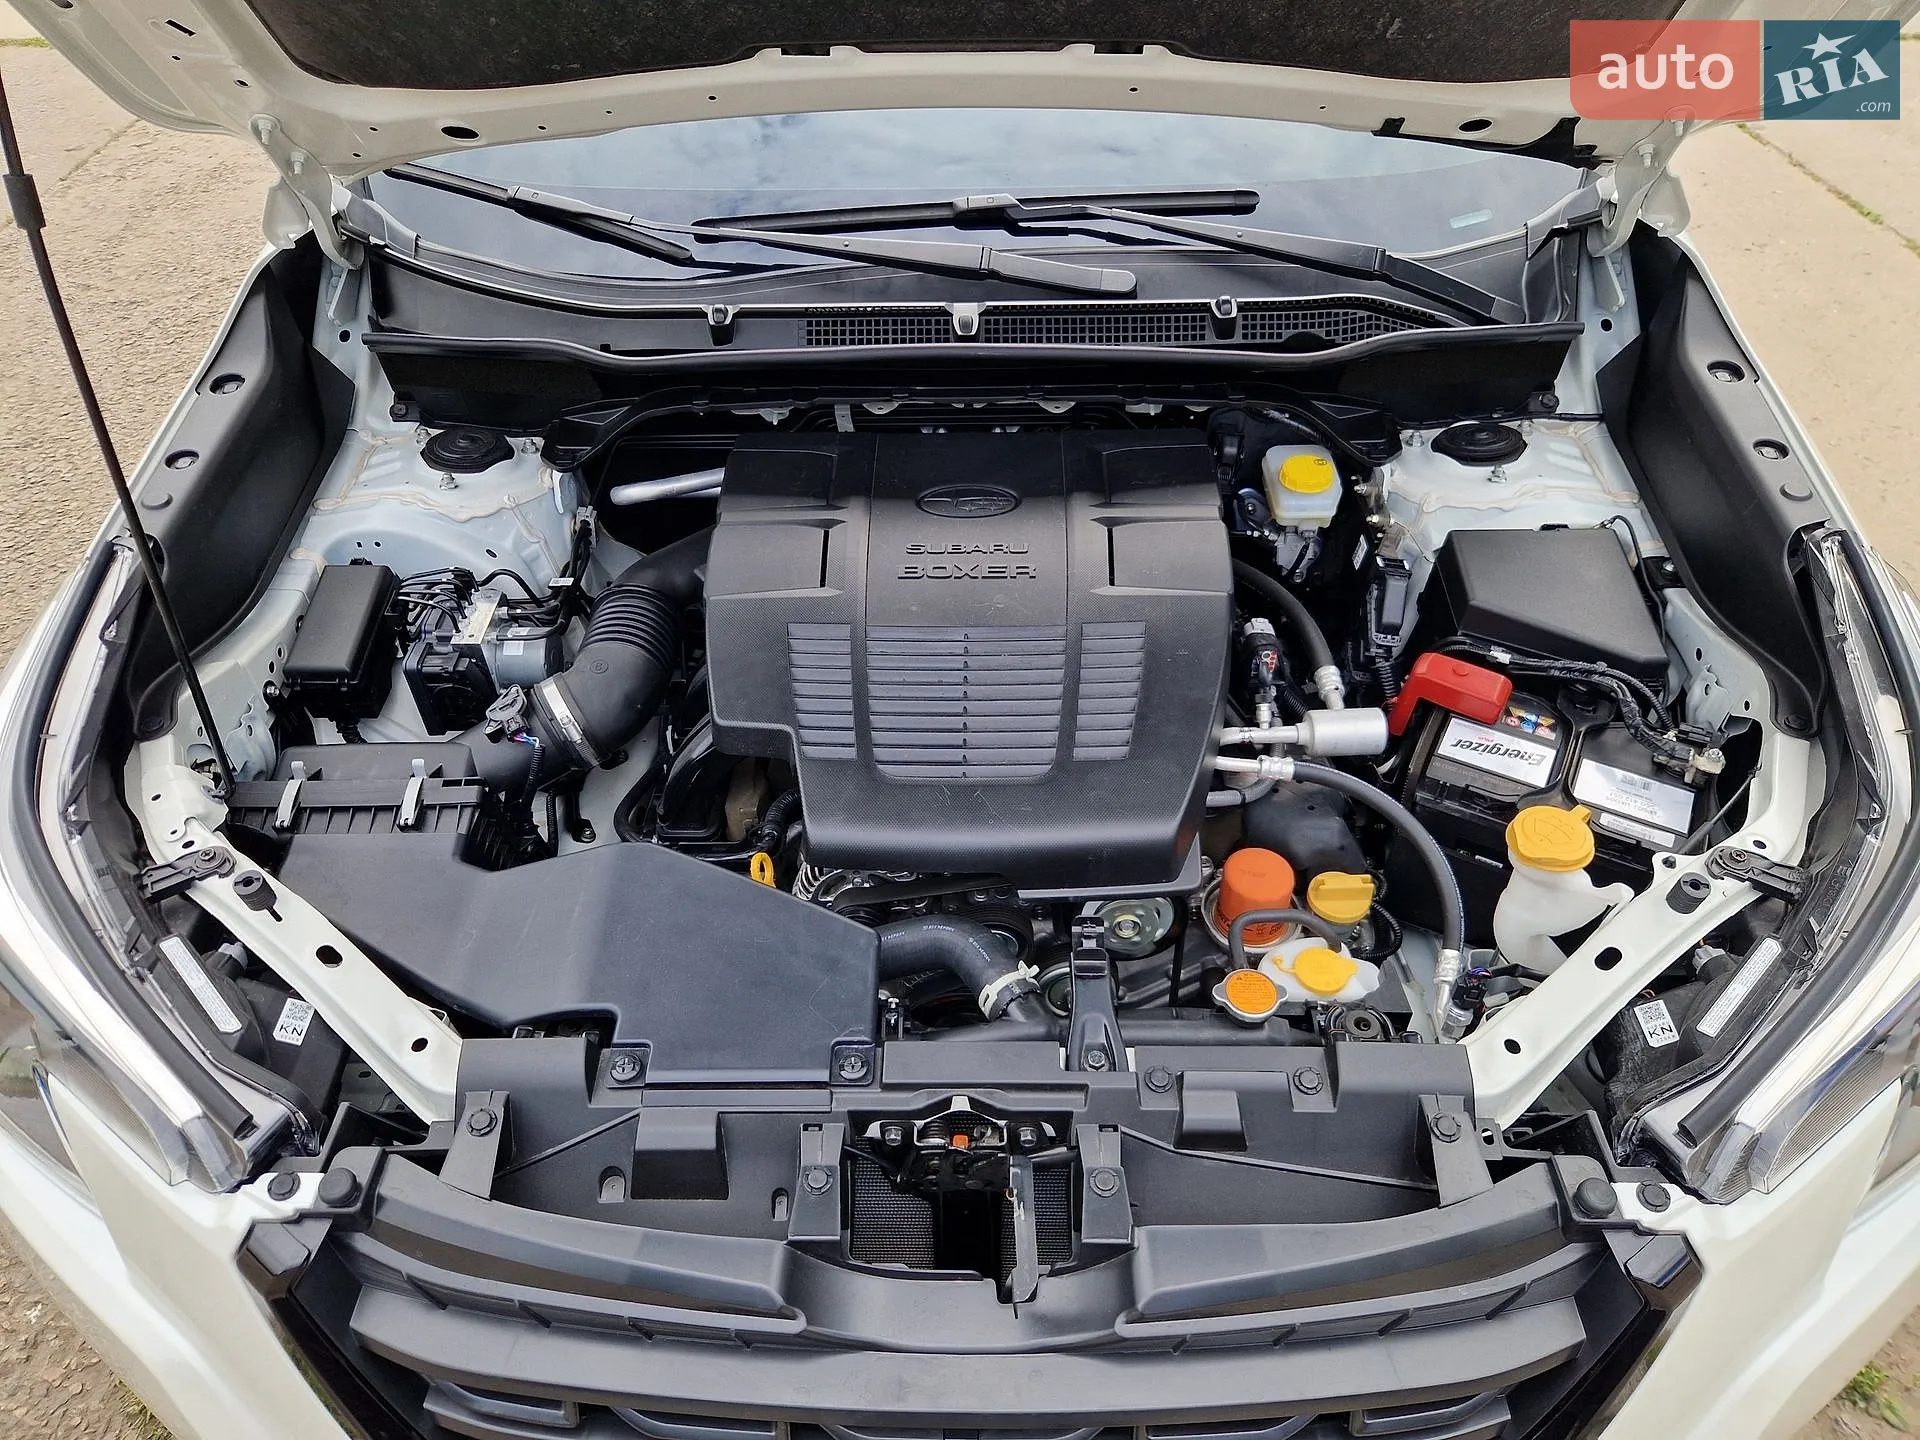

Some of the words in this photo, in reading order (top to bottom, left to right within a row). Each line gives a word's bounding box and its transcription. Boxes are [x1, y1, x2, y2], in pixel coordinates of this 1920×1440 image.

[905, 543, 1029, 554] SUBARU
[897, 564, 1037, 579] BOXER
[1450, 738, 1547, 766] Energizer
[279, 1024, 304, 1037] KN
[1648, 1025, 1674, 1039] KN
